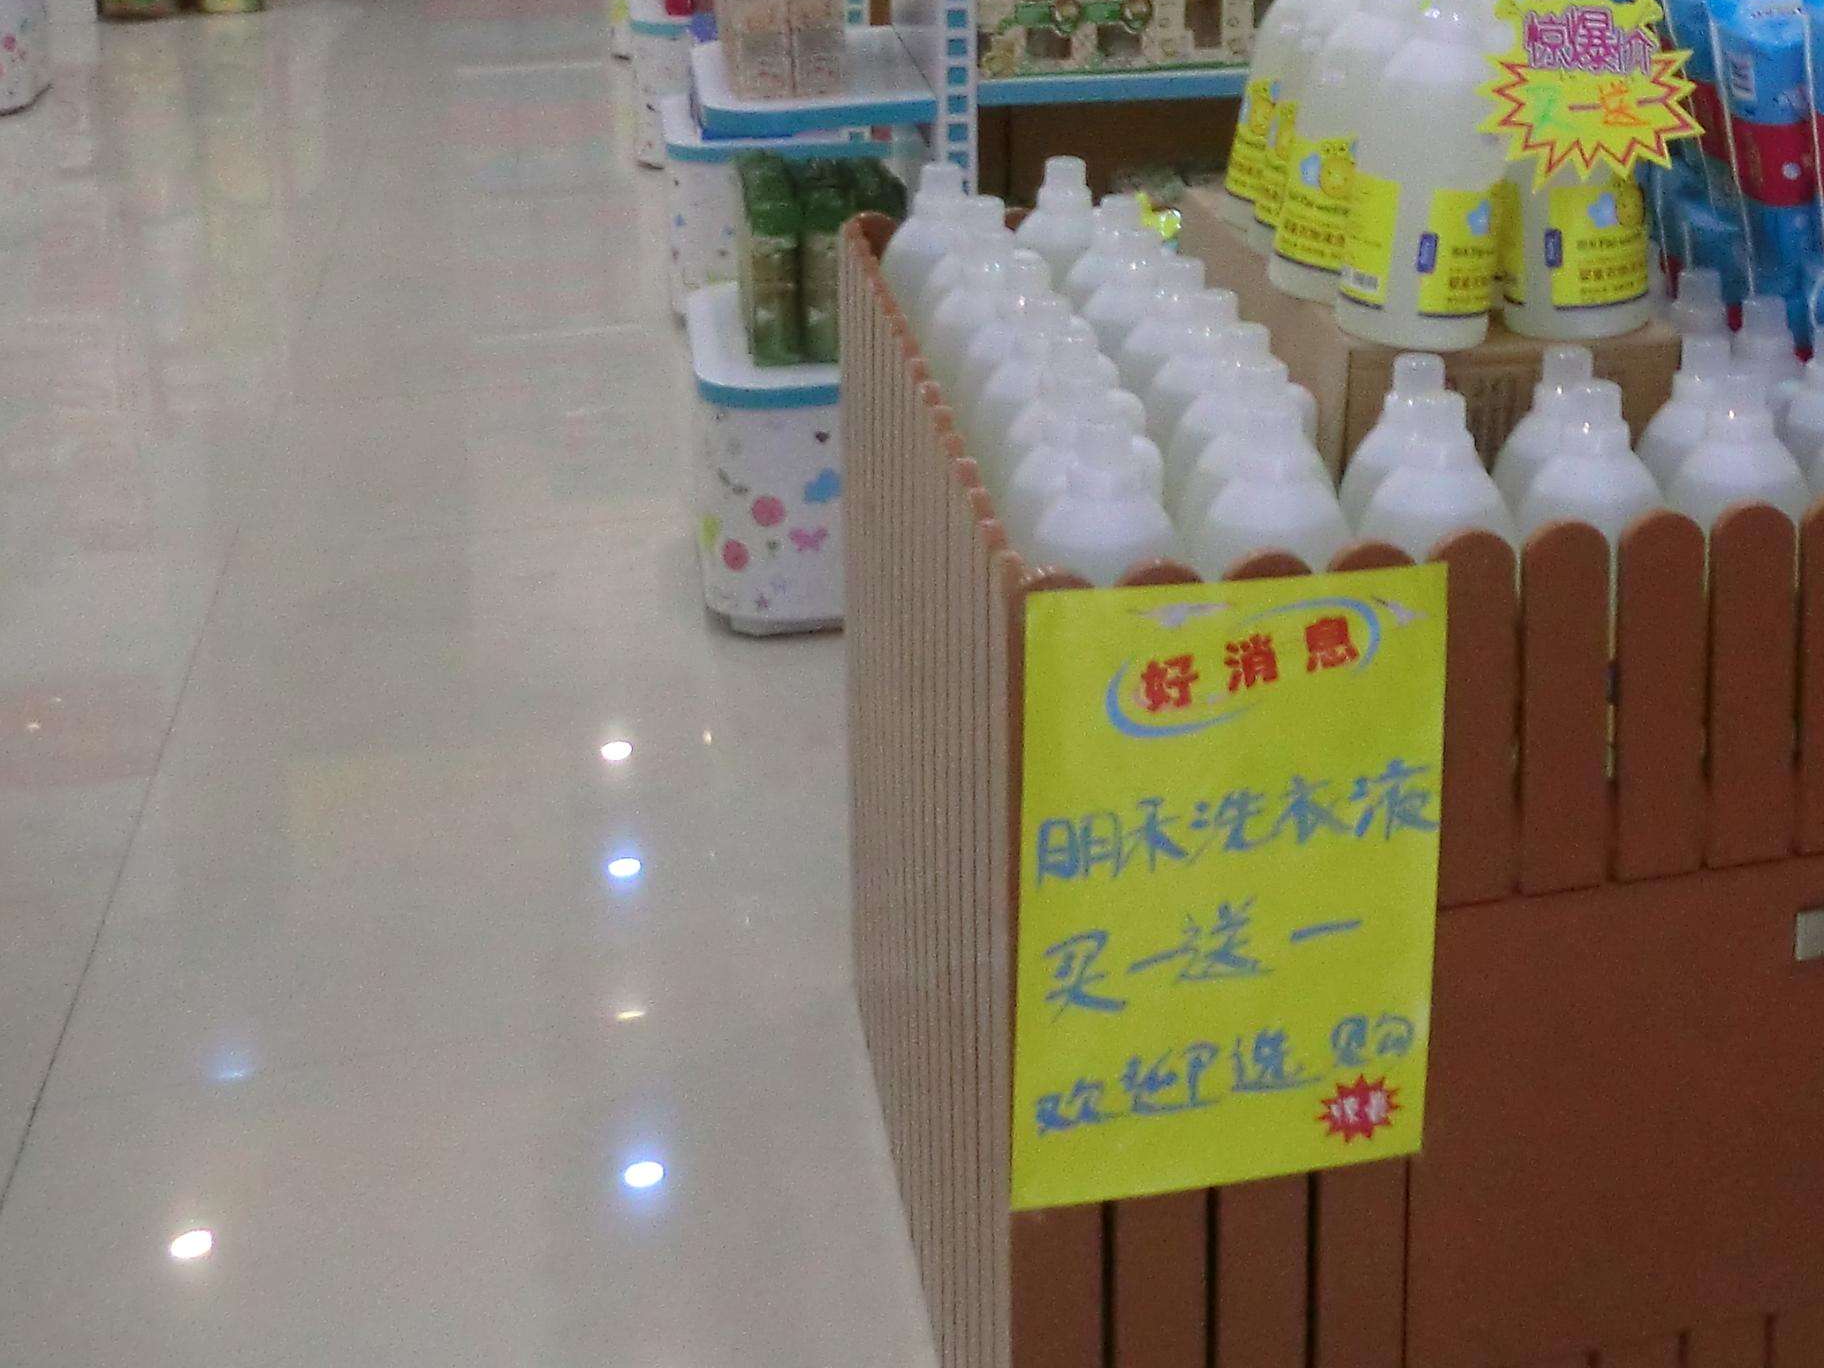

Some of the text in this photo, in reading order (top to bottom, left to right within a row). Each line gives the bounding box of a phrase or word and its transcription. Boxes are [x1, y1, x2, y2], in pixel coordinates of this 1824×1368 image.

[1525, 6, 1660, 75] 惊爆价
[1138, 616, 1360, 712] 好消息
